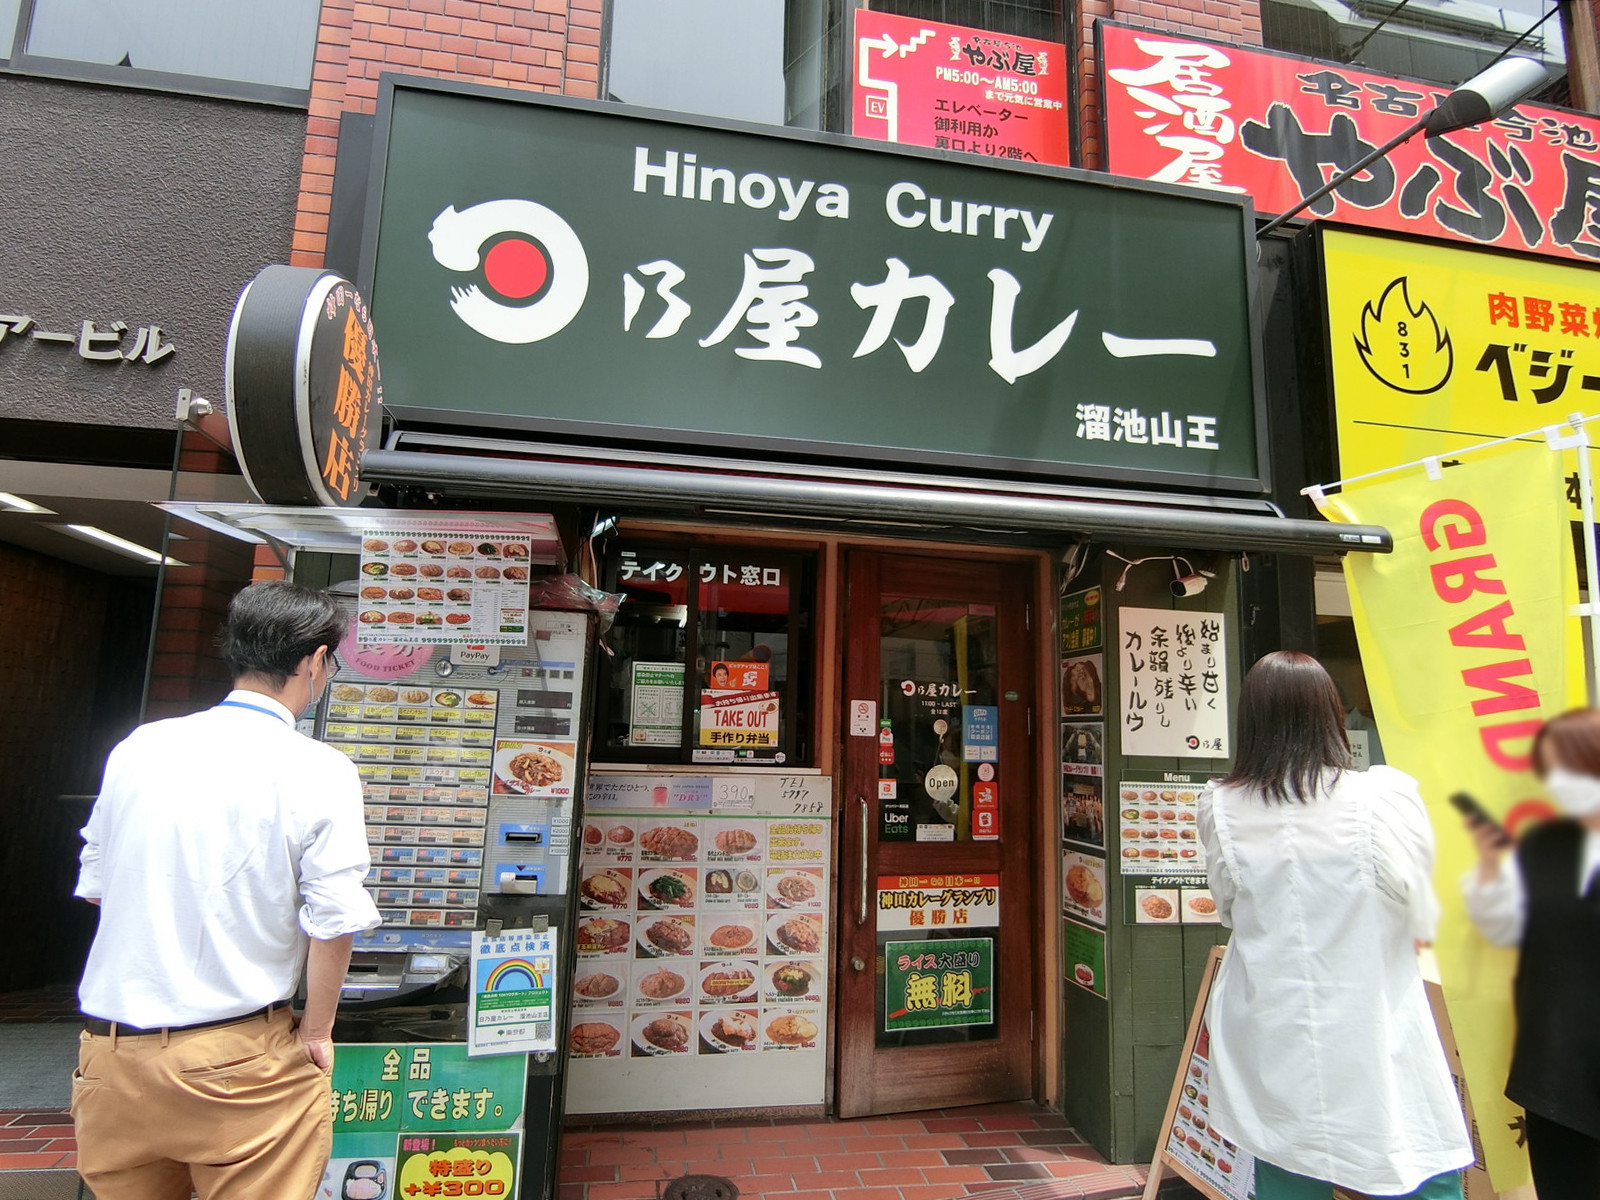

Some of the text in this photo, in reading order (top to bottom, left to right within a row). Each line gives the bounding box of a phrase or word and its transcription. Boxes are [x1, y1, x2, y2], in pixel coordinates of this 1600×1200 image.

[962, 43, 1036, 76] やぶ屋
[870, 102, 885, 115] EV
[934, 98, 1029, 122] エレベーター
[985, 89, 1063, 111] まで元気に営業中
[1108, 37, 1247, 194] 居酒屋
[1296, 70, 1600, 153] 名古今池
[632, 146, 1054, 253] Hinoya Curry
[1487, 291, 1600, 339] 肉野菜
[322, 305, 369, 501] 優勝店
[1075, 403, 1221, 451] 溜池山王
[620, 560, 781, 587] テイクウト窓口
[355, 657, 415, 672] FOOD TICKET
[460, 651, 490, 661] PayPay
[1200, 618, 1220, 711] 始まり甘く
[1175, 623, 1197, 712] 後より辛い
[1125, 630, 1148, 732] カレールウ
[714, 709, 769, 728] TAKE OUT
[710, 731, 770, 744] 手作り弁当
[929, 778, 954, 790] Open
[1163, 772, 1191, 782] Menu
[550, 787, 570, 795] ¥1000
[884, 812, 909, 823] Uber
[884, 824, 909, 834] Eats
[879, 887, 997, 910] 神田カレーグランプリ
[909, 908, 968, 926] 優勝店
[480, 941, 550, 955] 徹底点検済
[897, 951, 980, 971] ライス大盛り
[905, 970, 974, 1012] 無料
[381, 1047, 431, 1082] 全品
[407, 1087, 505, 1121] できます。
[428, 1158, 493, 1178] 特盛り
[403, 1179, 505, 1197] +¥300
